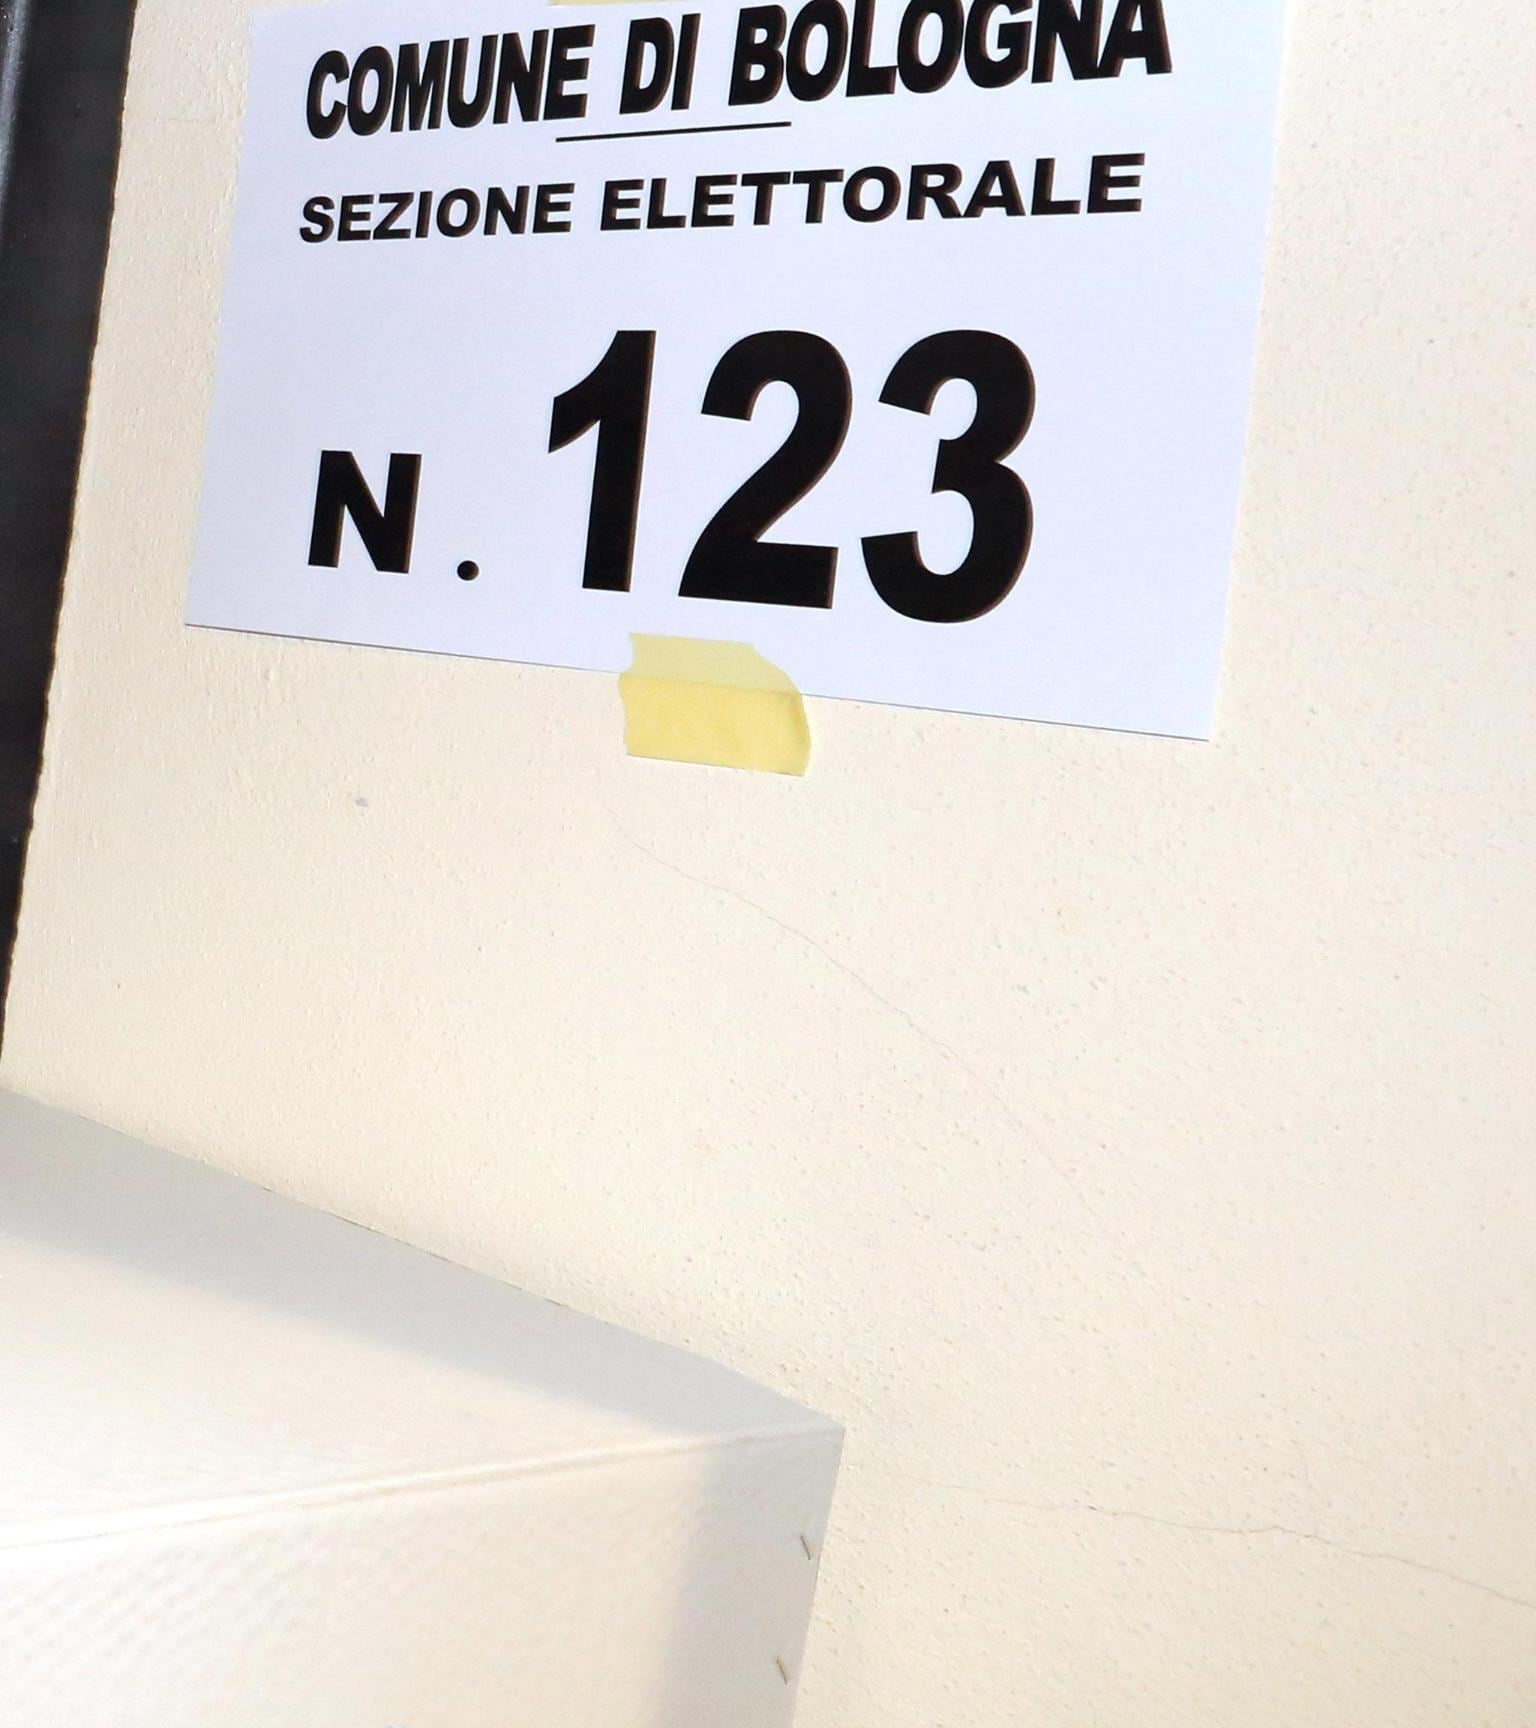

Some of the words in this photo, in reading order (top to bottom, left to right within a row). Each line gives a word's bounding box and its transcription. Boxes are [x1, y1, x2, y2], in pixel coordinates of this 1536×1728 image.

[307, 24, 596, 140] COMUNE
[619, 13, 702, 115] DI
[727, 0, 1172, 107] BOLOGNA
[299, 183, 575, 243] SEZIONE
[600, 153, 1145, 231] ELETTORALE
[547, 329, 1037, 624] 123
